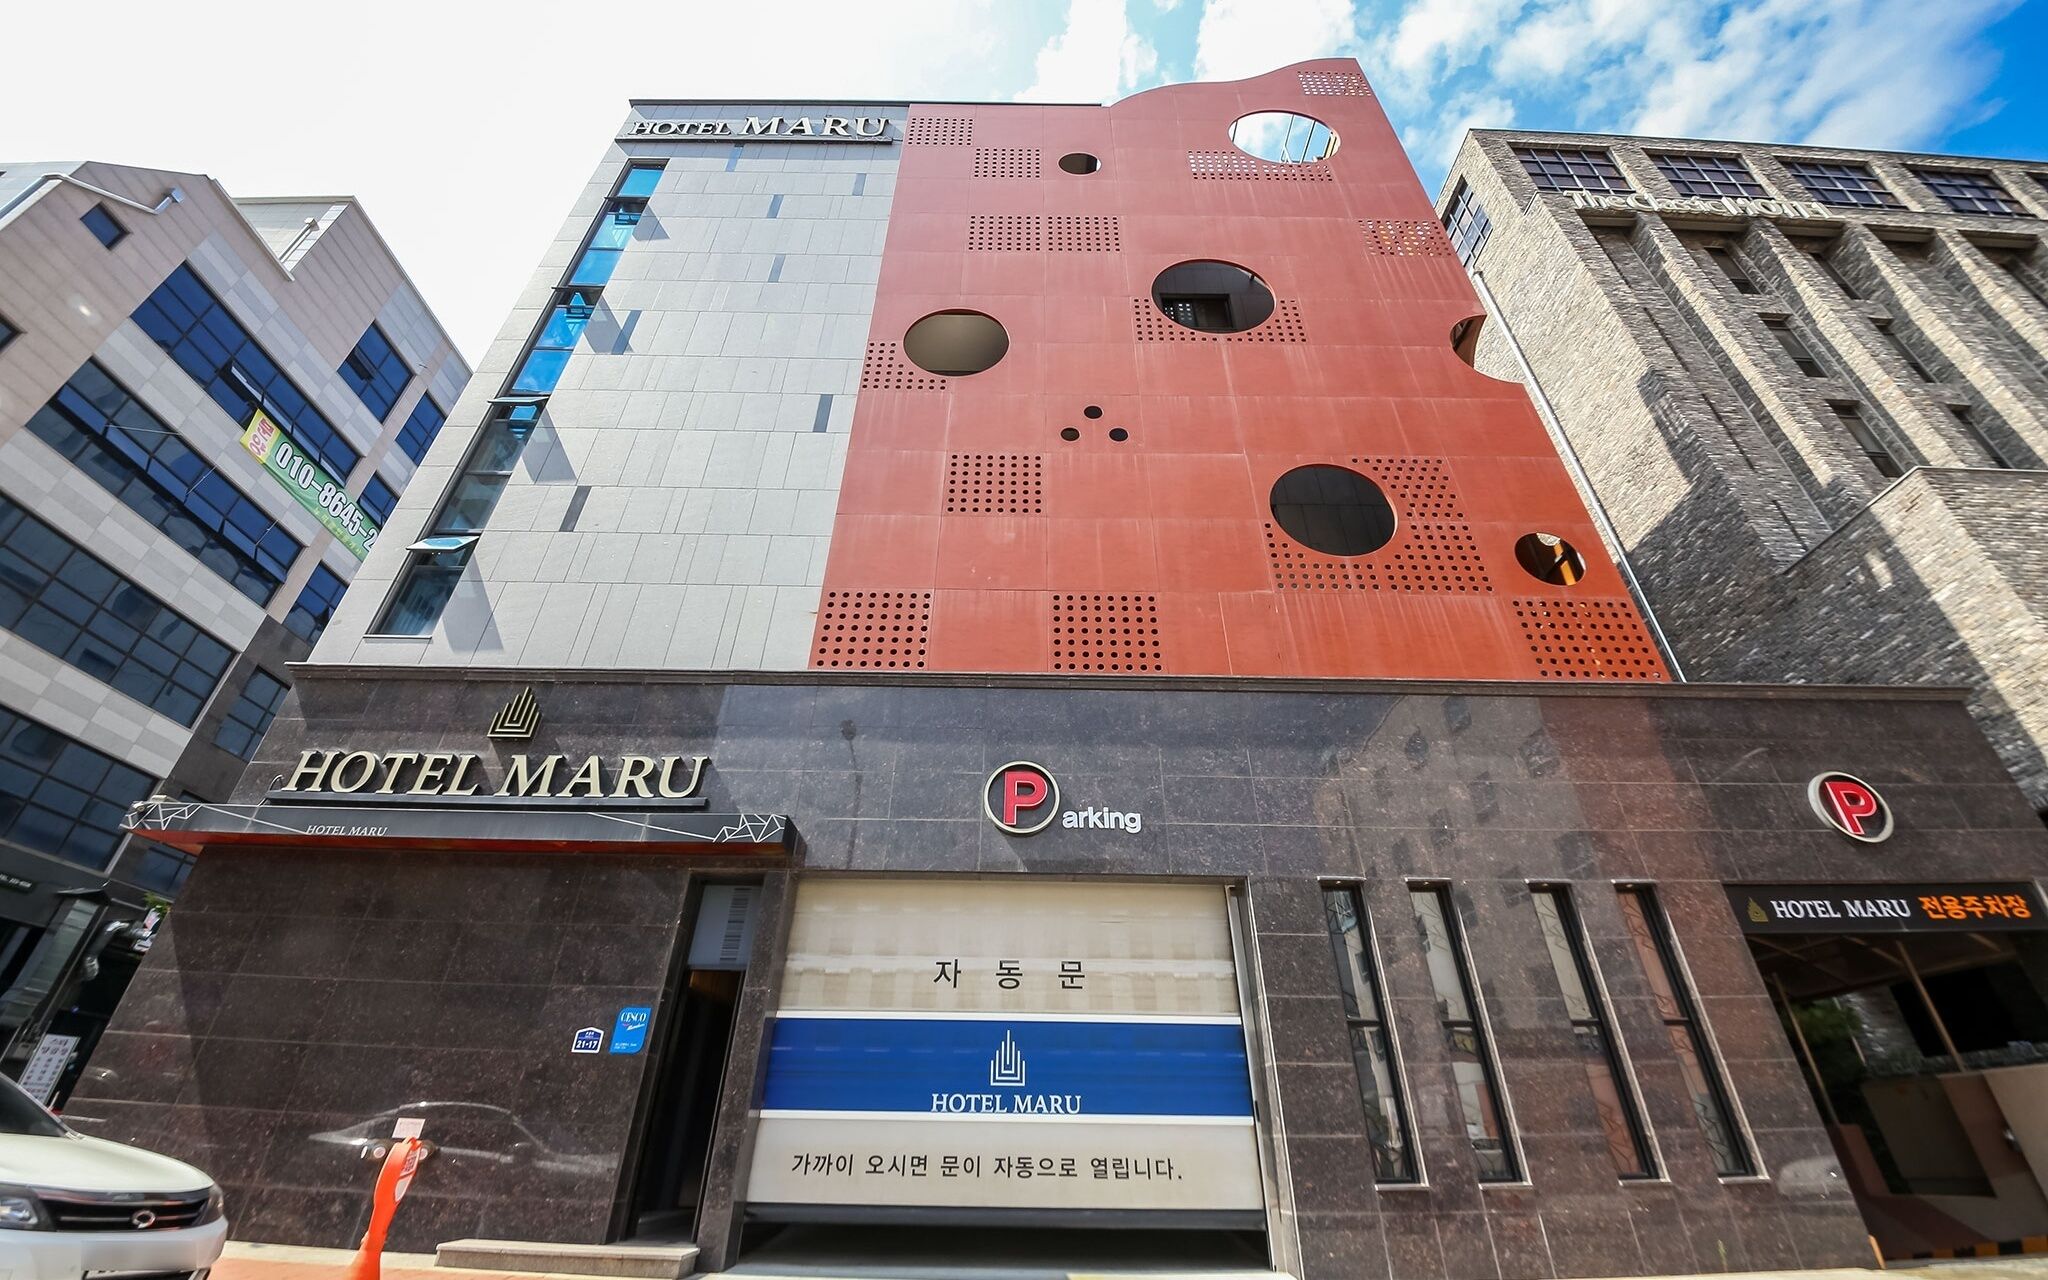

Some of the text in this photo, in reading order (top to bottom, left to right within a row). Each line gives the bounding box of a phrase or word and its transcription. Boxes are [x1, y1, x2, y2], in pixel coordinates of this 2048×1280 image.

[628, 116, 890, 137] HOTEL MARU
[282, 750, 711, 799] HOTEL MARU
[1824, 781, 1878, 836] P
[305, 824, 388, 837] HOTEL MARU
[1770, 894, 2032, 920] HOTEL MARU 전용주차장
[931, 1093, 1082, 1115] HOTEL MARU
[791, 1154, 1183, 1180] 가까이 오시면 문이 자동으로 열립니다.
